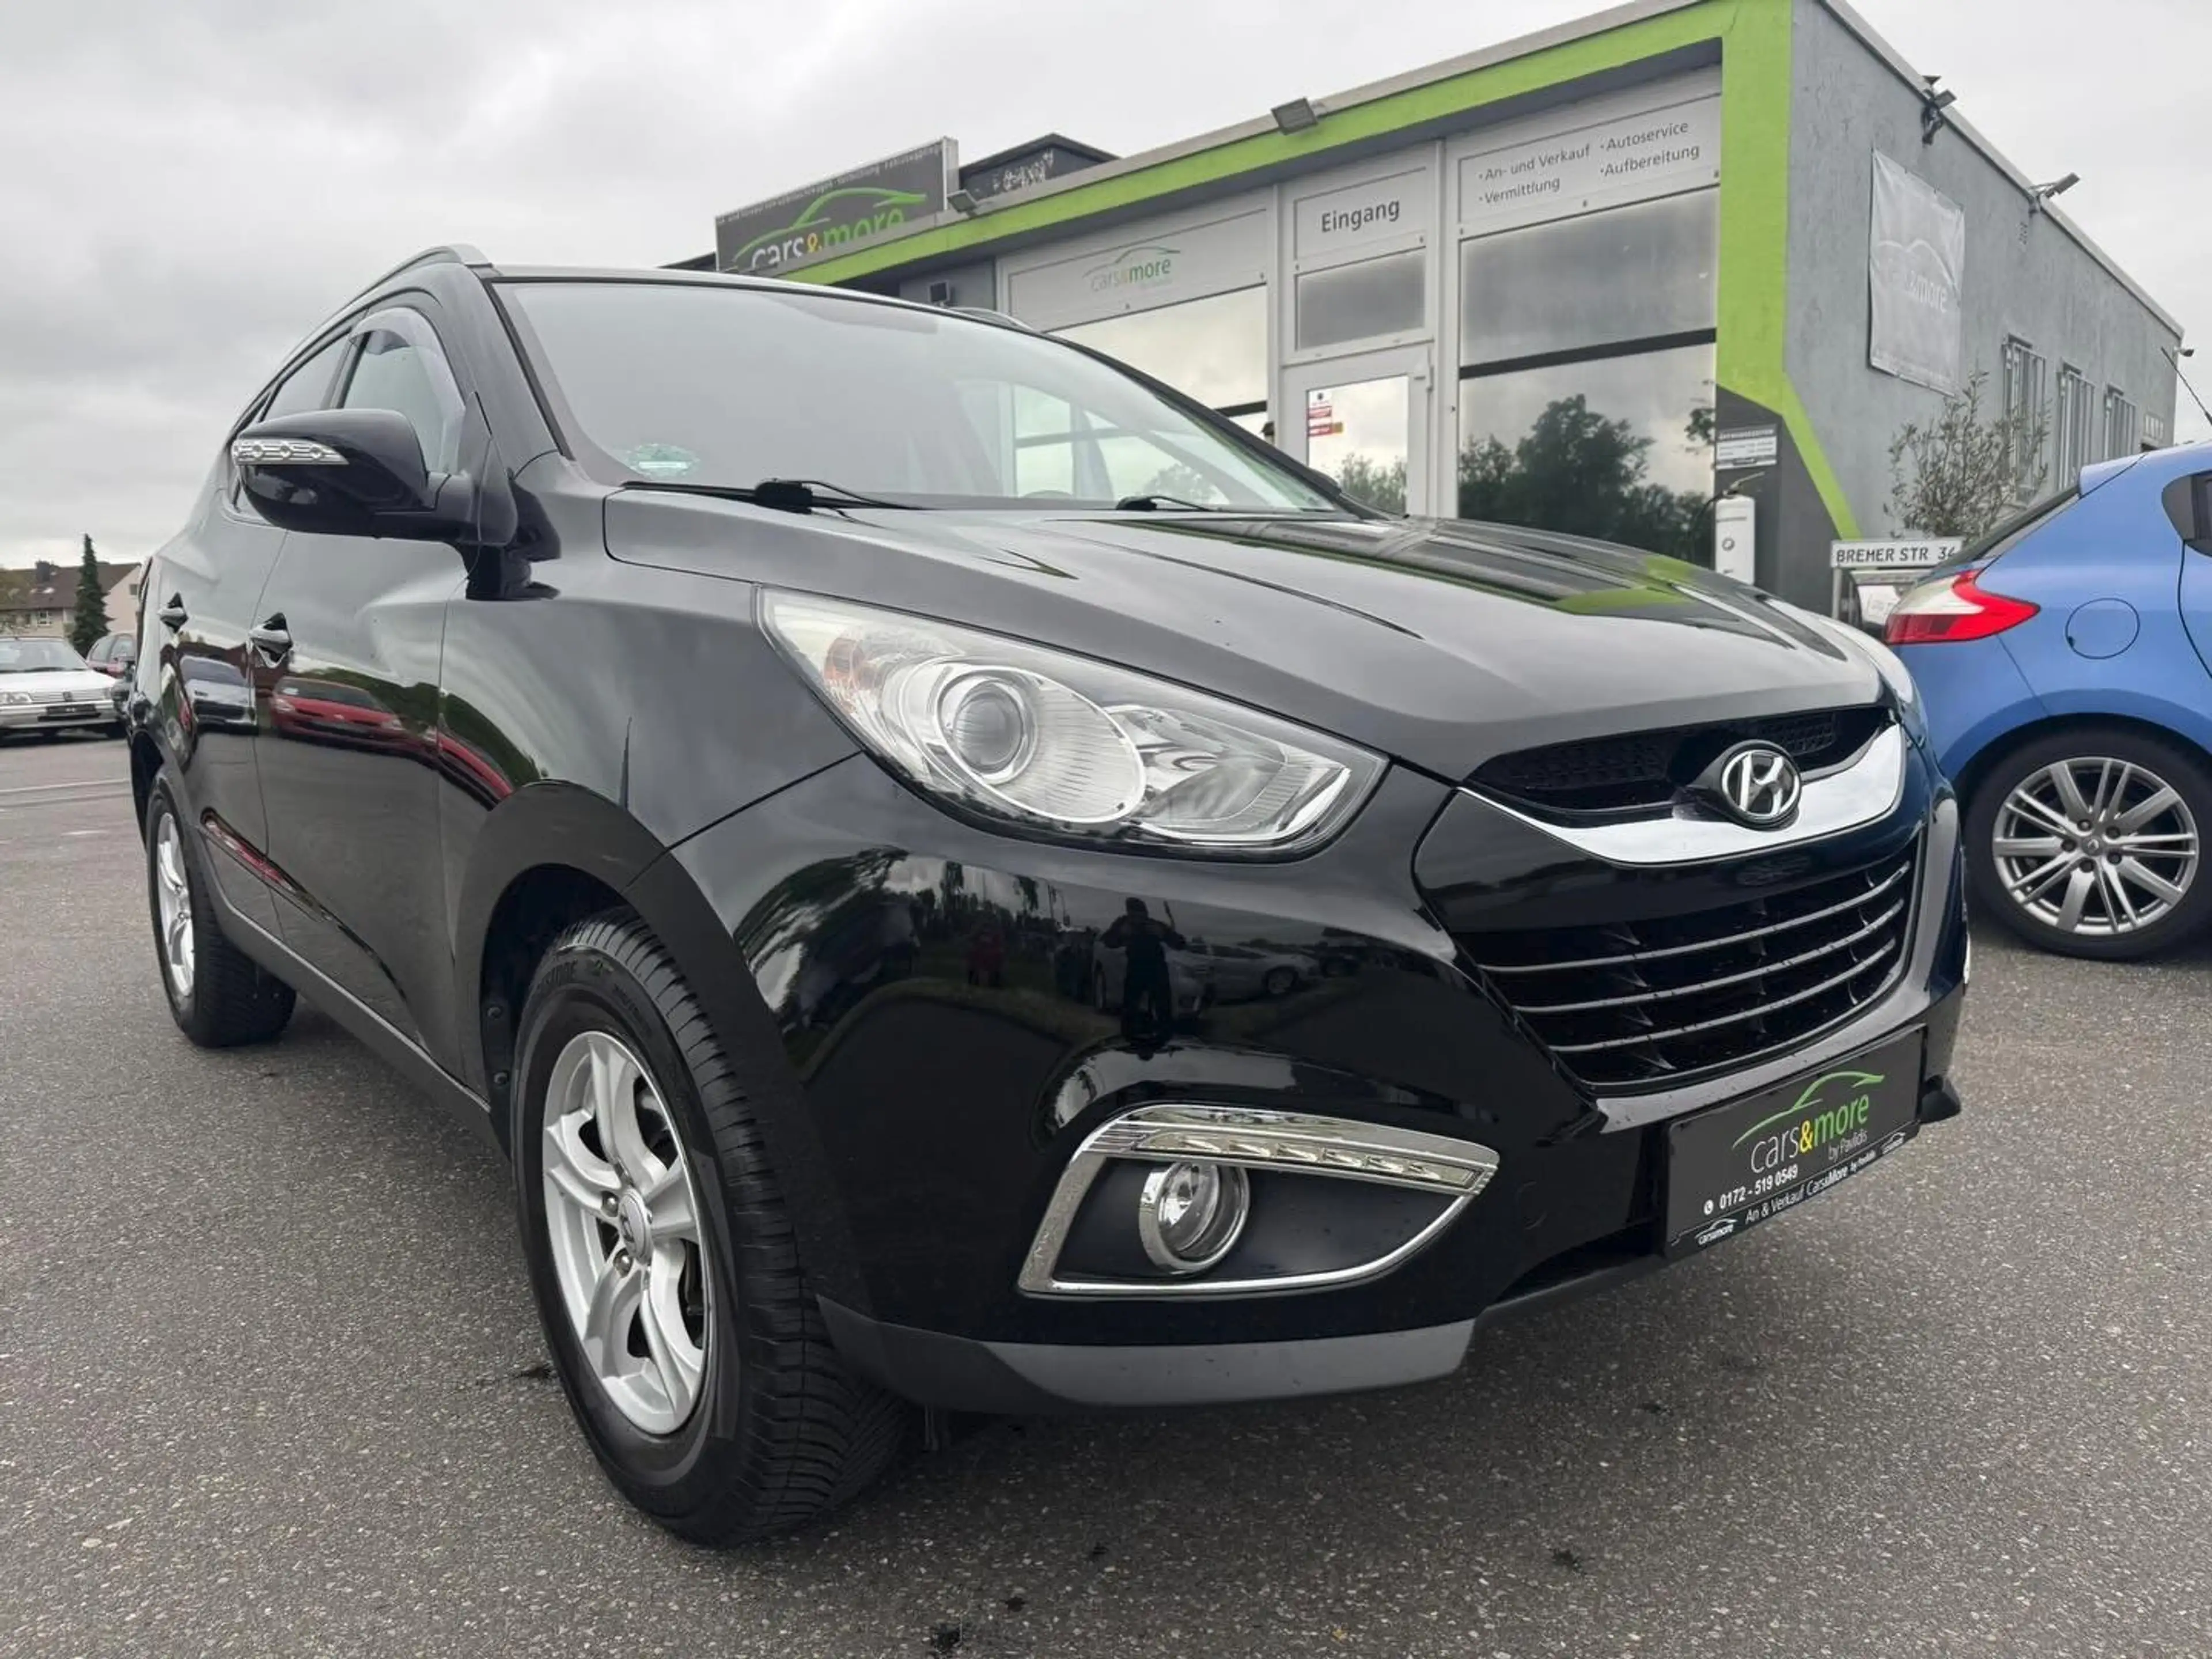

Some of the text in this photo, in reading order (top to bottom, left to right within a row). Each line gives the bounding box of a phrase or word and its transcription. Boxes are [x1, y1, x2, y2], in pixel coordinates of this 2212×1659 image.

[1606, 123, 1689, 151] Autoservice
[1510, 157, 1535, 175] und
[1538, 143, 1590, 168] Verkauf
[1605, 146, 1700, 177] Aufbereitung
[1484, 177, 1560, 203] Vermittlung
[1321, 200, 1400, 233] Eingang
[1836, 548, 1895, 563] BREMER
[1899, 547, 1929, 562] STR
[1751, 1094, 1869, 1174] cars&more
[1719, 1186, 1746, 1210] 0172
[1755, 1175, 1774, 1195] 519
[1745, 1209, 1759, 1225] An
